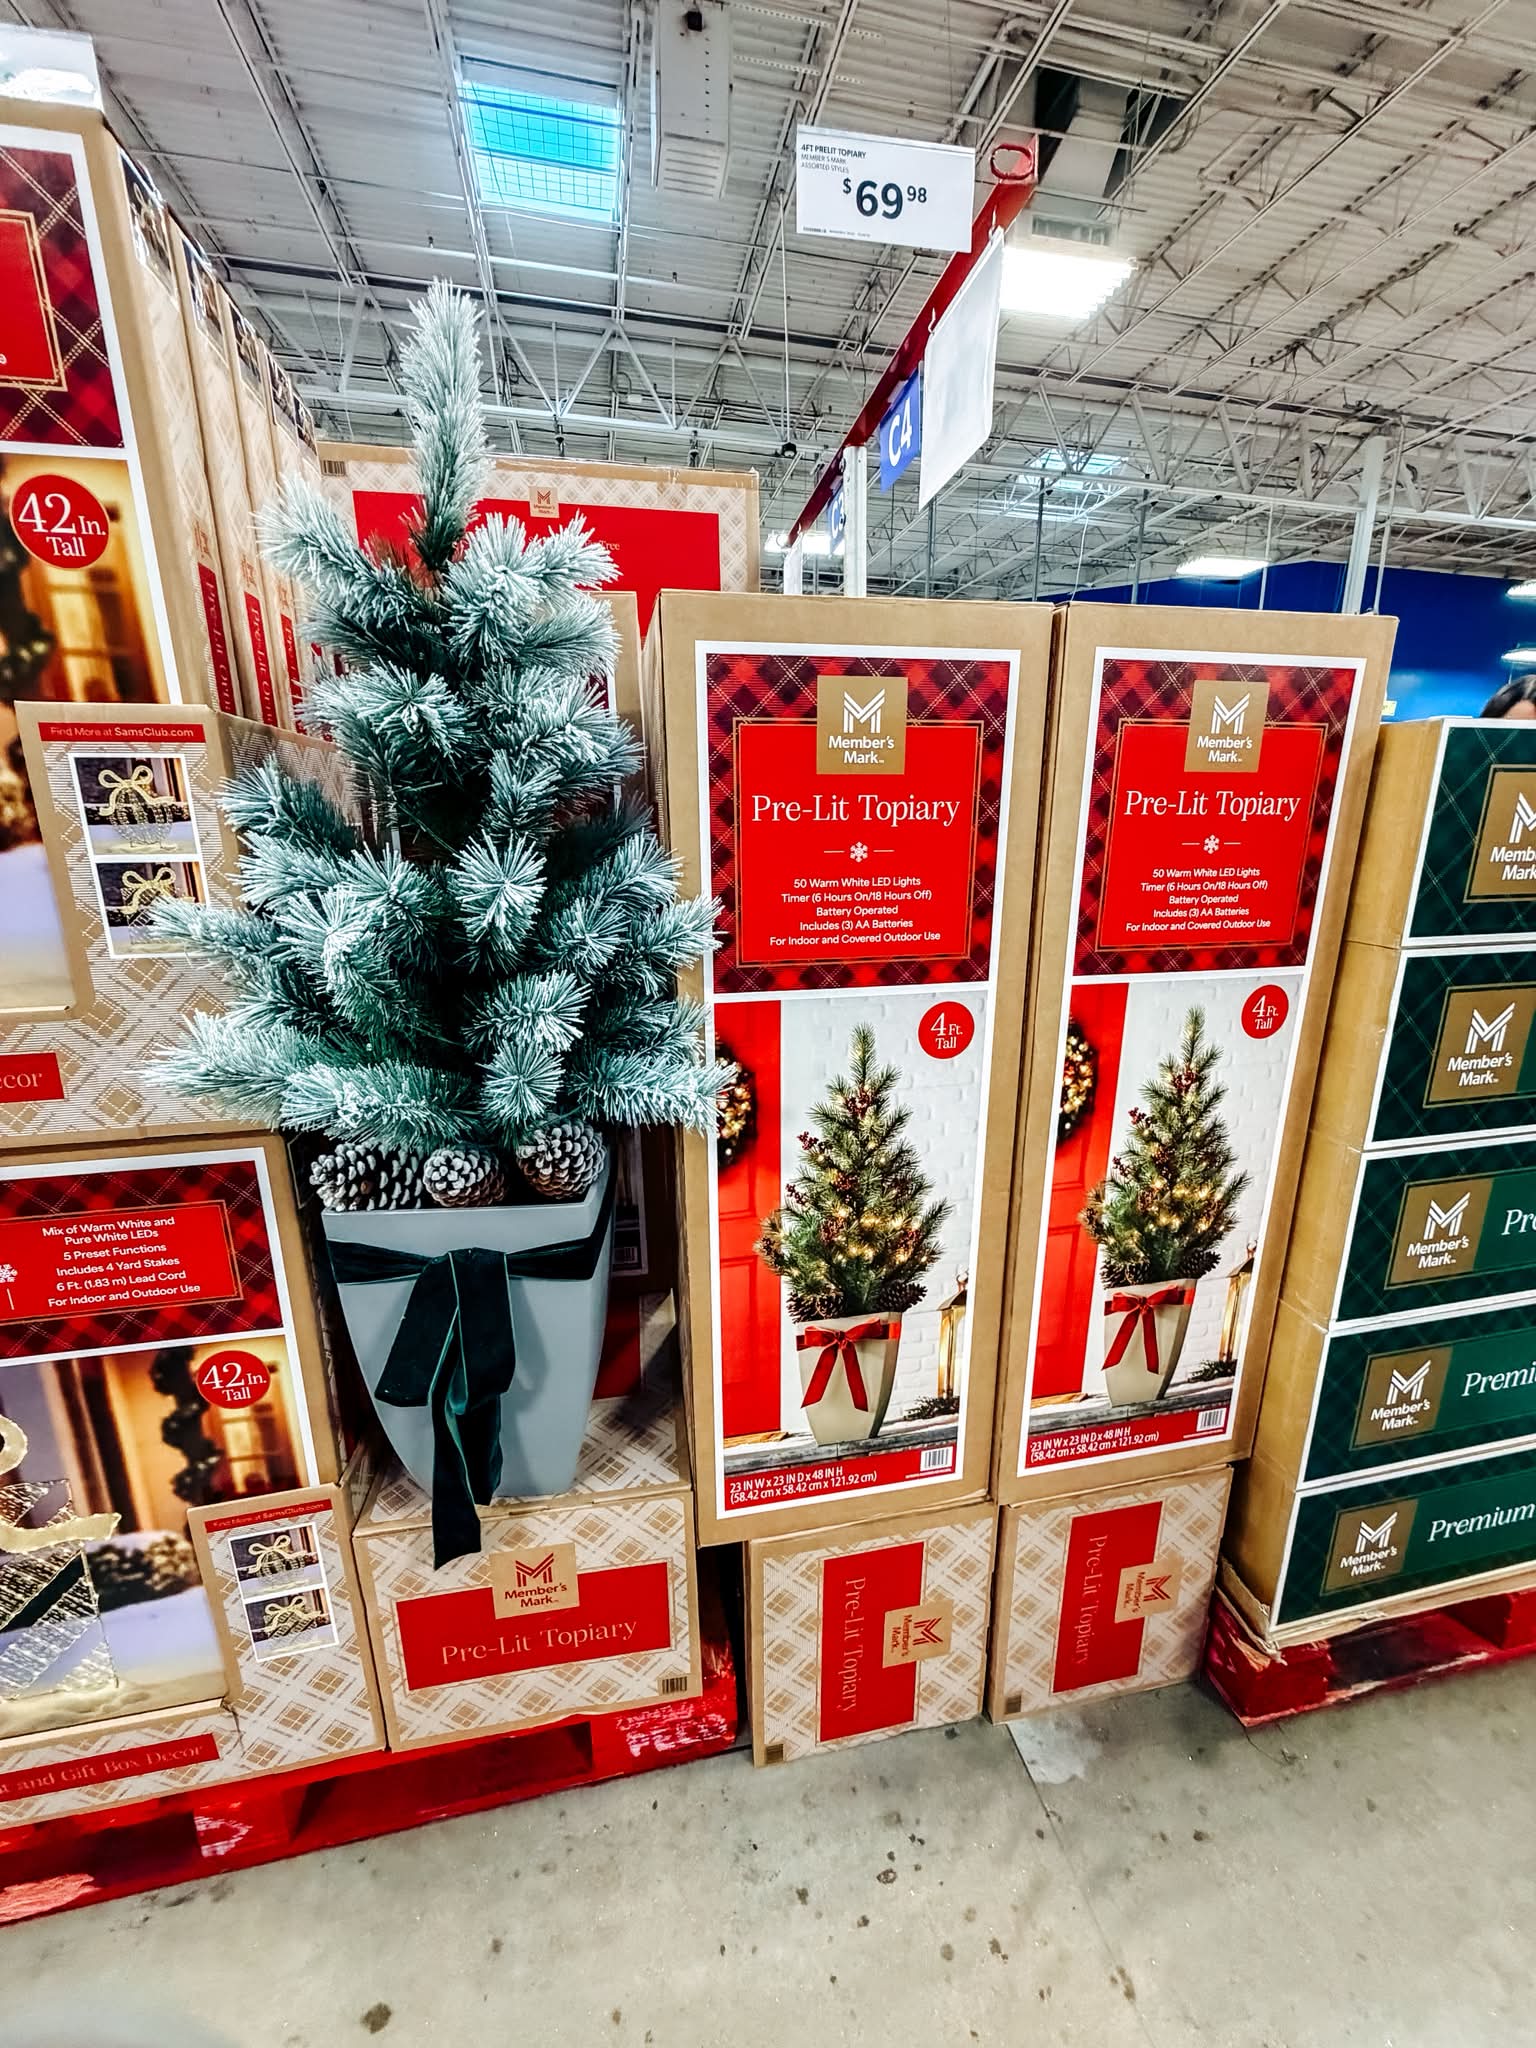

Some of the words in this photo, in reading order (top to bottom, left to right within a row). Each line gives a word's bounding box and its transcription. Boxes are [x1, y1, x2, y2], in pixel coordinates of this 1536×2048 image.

[801, 144, 813, 152] 4FT
[815, 145, 837, 154] PRELIT
[838, 148, 867, 158] TOPIARY
[831, 164, 850, 174] STYLES
[889, 396, 913, 467] C4
[18, 492, 76, 534] 42
[80, 516, 107, 536] In.
[46, 536, 87, 558] Tall
[50, 726, 73, 736] Find
[74, 727, 101, 736] More
[103, 728, 113, 736] at
[114, 726, 194, 737] SamsClub.com
[828, 735, 895, 750] Member's
[1197, 735, 1253, 750] Member's
[751, 794, 850, 822] Pre-Lit
[857, 793, 961, 827] Topiary
[1124, 790, 1208, 816] Pre-Lit
[1215, 790, 1301, 822] Topiary
[1490, 846, 1536, 862] Memb
[793, 878, 807, 889] 50
[809, 878, 839, 888] Warm
[841, 877, 869, 887] White
[871, 877, 891, 887] LED
[893, 876, 921, 887] Lights
[1152, 869, 1164, 878] 50
[1166, 869, 1191, 878] Warm
[1193, 868, 1218, 877] White
[1219, 868, 1235, 877] LED
[1236, 867, 1260, 878] Lights
[781, 893, 809, 903] Timer
[812, 892, 822, 903] (6
[823, 892, 852, 902] Hours
[854, 891, 882, 901] On/18
[884, 891, 911, 901] Hours
[913, 889, 932, 900] Off)
[1141, 882, 1165, 892] Timer
[1167, 881, 1176, 892] (6
[1177, 881, 1201, 891] Hours
[1202, 881, 1226, 891] On/18
[1227, 881, 1250, 890] Hours
[1252, 880, 1268, 890] Off)
[1169, 895, 1199, 905] Battery
[1200, 894, 1239, 905] Operated
[816, 906, 852, 917] Battery
[853, 905, 898, 916] Operated
[1153, 908, 1187, 918] Includes
[1188, 908, 1199, 918] (3)
[1200, 908, 1213, 916] AA
[1214, 907, 1249, 916] Batteries
[800, 921, 839, 931] Includes
[841, 920, 853, 931] (3)
[855, 919, 870, 929] AA
[872, 918, 913, 929] Batteries
[1126, 923, 1140, 931] For
[1141, 922, 1168, 931] Indoor
[1170, 921, 1186, 930] and
[1187, 920, 1221, 930] Covered
[1222, 919, 1256, 929] Outdoor
[1256, 919, 1271, 928] Use
[769, 937, 786, 946] For
[788, 935, 819, 945] Indoor
[822, 935, 839, 944] and
[841, 933, 882, 944] Covered
[883, 932, 922, 942] Outdoor
[924, 931, 941, 941] Use
[1251, 994, 1266, 1018] 4
[930, 1012, 947, 1036] 4
[948, 1023, 963, 1035] Ft.
[1255, 1017, 1273, 1030] Tall
[935, 1036, 957, 1049] Tall
[1447, 1052, 1513, 1071] Member's
[41, 1226, 64, 1237] Mix
[65, 1225, 78, 1234] of
[79, 1223, 116, 1233] Warm
[116, 1219, 152, 1230] White
[153, 1216, 175, 1226] and
[64, 1235, 92, 1246] Pure
[93, 1232, 128, 1243] White
[130, 1229, 159, 1239] LEDs
[1407, 1235, 1469, 1257] Member's
[63, 1251, 72, 1261] 5
[74, 1248, 111, 1260] Preset
[112, 1243, 167, 1256] Functions
[56, 1264, 104, 1276] Includes
[105, 1262, 114, 1271] 4
[115, 1259, 142, 1271] Yard
[143, 1257, 180, 1268] Stakes
[56, 1282, 65, 1291] 6
[66, 1281, 83, 1291] Ft.
[84, 1277, 110, 1290] (1.83
[111, 1276, 127, 1287] m)
[128, 1273, 156, 1284] Lead
[158, 1270, 187, 1281] Cord
[47, 1297, 67, 1307] For
[69, 1293, 107, 1305] Indoor
[108, 1290, 130, 1301] and
[131, 1286, 178, 1299] Outdoor
[180, 1284, 201, 1294] Use
[202, 1362, 245, 1390] 42
[246, 1372, 267, 1385] In.
[1461, 1361, 1536, 1397] Premi
[222, 1386, 251, 1402] Tall
[1370, 1398, 1431, 1421] Member's
[730, 1482, 742, 1492] 23
[743, 1480, 752, 1491] IN
[752, 1478, 765, 1489] W
[773, 1475, 785, 1486] 23
[786, 1473, 796, 1484] IN
[797, 1471, 805, 1482] D
[811, 1468, 823, 1480] 48
[825, 1467, 834, 1478] IN
[835, 1466, 843, 1476] H
[730, 1488, 759, 1505] (58.42
[760, 1489, 774, 1498] cm
[782, 1483, 807, 1496] 58.42
[809, 1482, 822, 1491] cm
[830, 1474, 859, 1488] 121.92
[860, 1471, 877, 1484] cm)
[1427, 1503, 1536, 1542] Premium
[1082, 1535, 1108, 1598] Pre-Lit
[1340, 1545, 1397, 1569] Member's
[504, 1582, 568, 1599] Member's
[844, 1576, 866, 1641] Pre-Lit
[1072, 1600, 1100, 1664] Topiary
[441, 1635, 532, 1665] Pre-Lit
[539, 1620, 637, 1650] Topiary
[836, 1644, 864, 1712] Topiary
[60, 1765, 97, 1782] Gift
[147, 1745, 203, 1766] Decor
